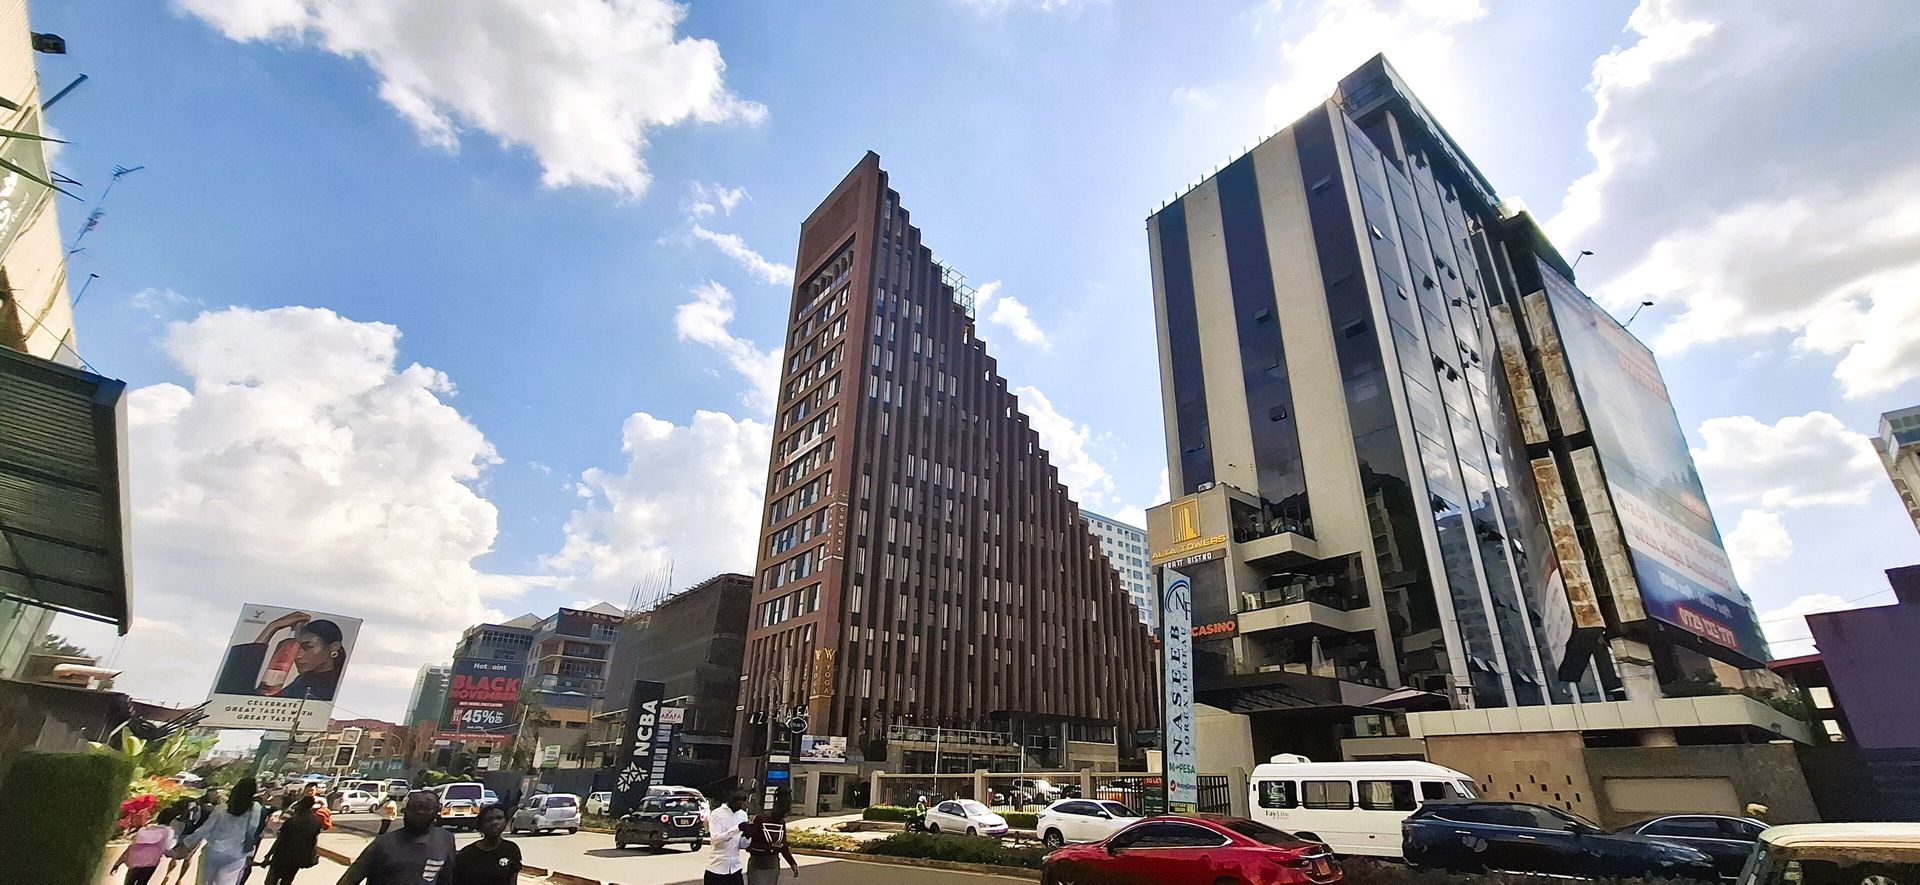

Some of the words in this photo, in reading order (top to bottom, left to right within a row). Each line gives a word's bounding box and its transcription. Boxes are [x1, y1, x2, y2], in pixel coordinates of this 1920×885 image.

[1178, 534, 1227, 551] TOWERS
[1187, 552, 1212, 564] BISTRO
[1190, 620, 1236, 637] CASINO
[453, 675, 520, 692] BLACK
[823, 664, 831, 694] YOGA
[450, 690, 518, 702] NOVEMBER
[1170, 625, 1184, 757] NASEEB
[247, 700, 298, 708] CELEBRATE
[461, 709, 495, 724] 45%
[633, 699, 659, 757] NCBA
